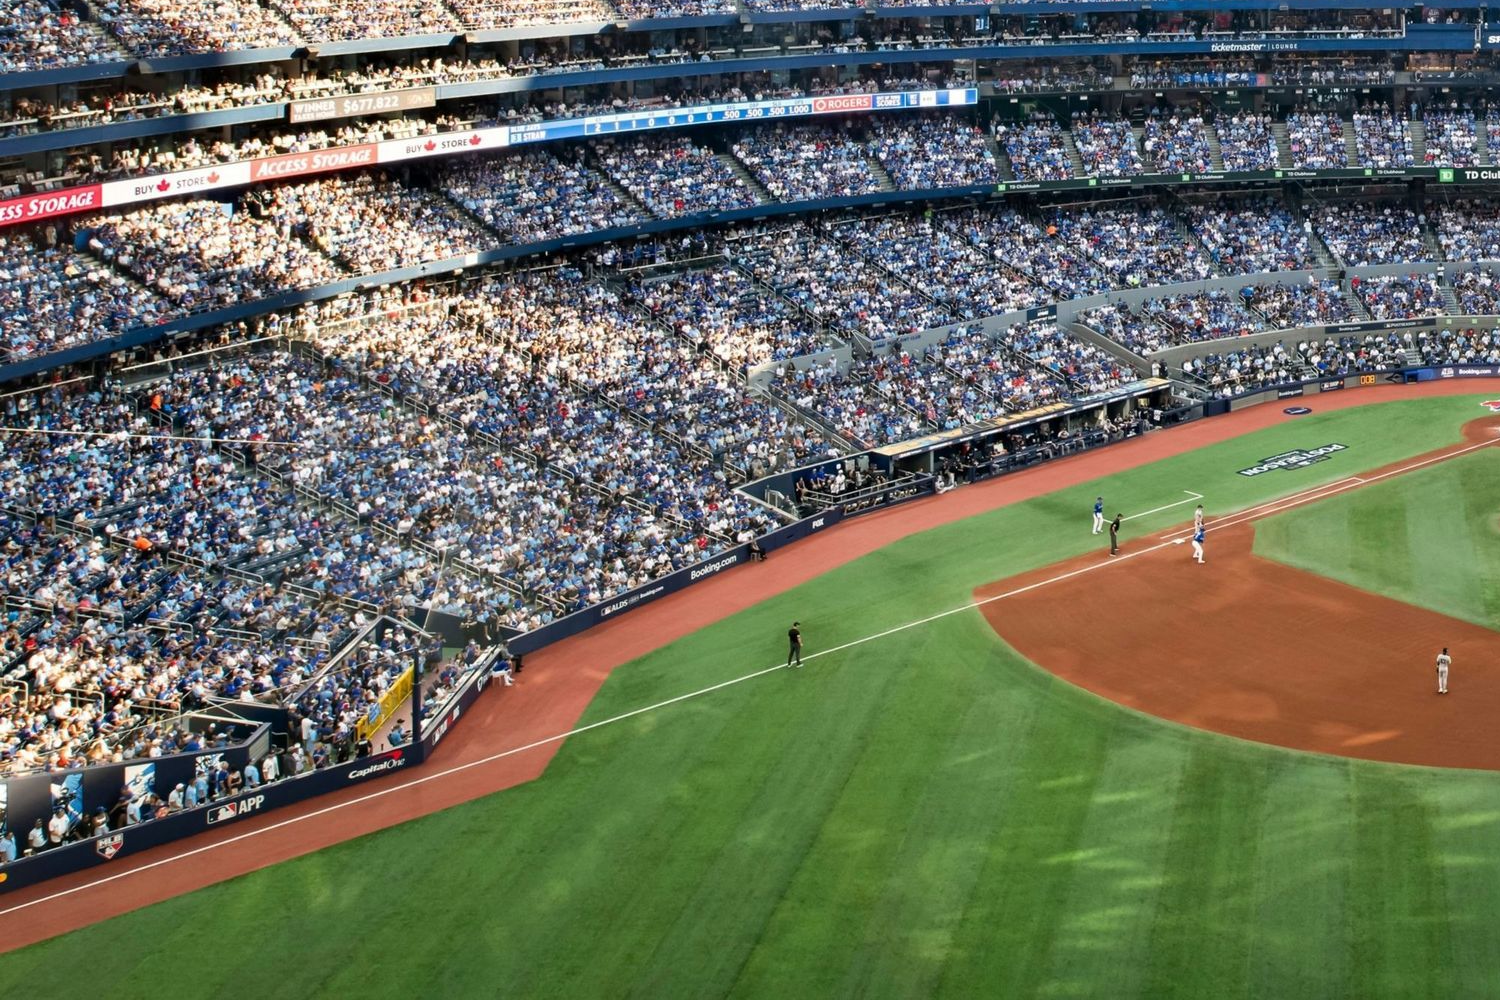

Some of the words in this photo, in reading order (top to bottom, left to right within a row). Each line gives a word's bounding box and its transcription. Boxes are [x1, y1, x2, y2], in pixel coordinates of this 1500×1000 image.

[1211, 42, 1263, 52] ticketmaster
[293, 100, 336, 114] WINNER
[828, 97, 868, 109] ROGERS
[876, 98, 901, 107] SCORES
[722, 110, 740, 119] .500
[745, 108, 763, 118] .500
[522, 130, 547, 142] STRAW
[405, 144, 422, 154] BUY
[441, 138, 467, 149] STORE
[256, 157, 308, 177] ACCESS
[312, 148, 371, 170] STORAGE
[1465, 171, 1479, 180] TD
[135, 184, 155, 196] BUY
[176, 176, 205, 189] STORE
[27, 191, 94, 217] STORAGE
[1240, 443, 1346, 476] POSTSEASON
[812, 518, 825, 529] FOX
[690, 555, 737, 580] Booking.com
[611, 599, 628, 611] ALDS
[238, 794, 265, 815] APP
[98, 833, 123, 848] MLB
